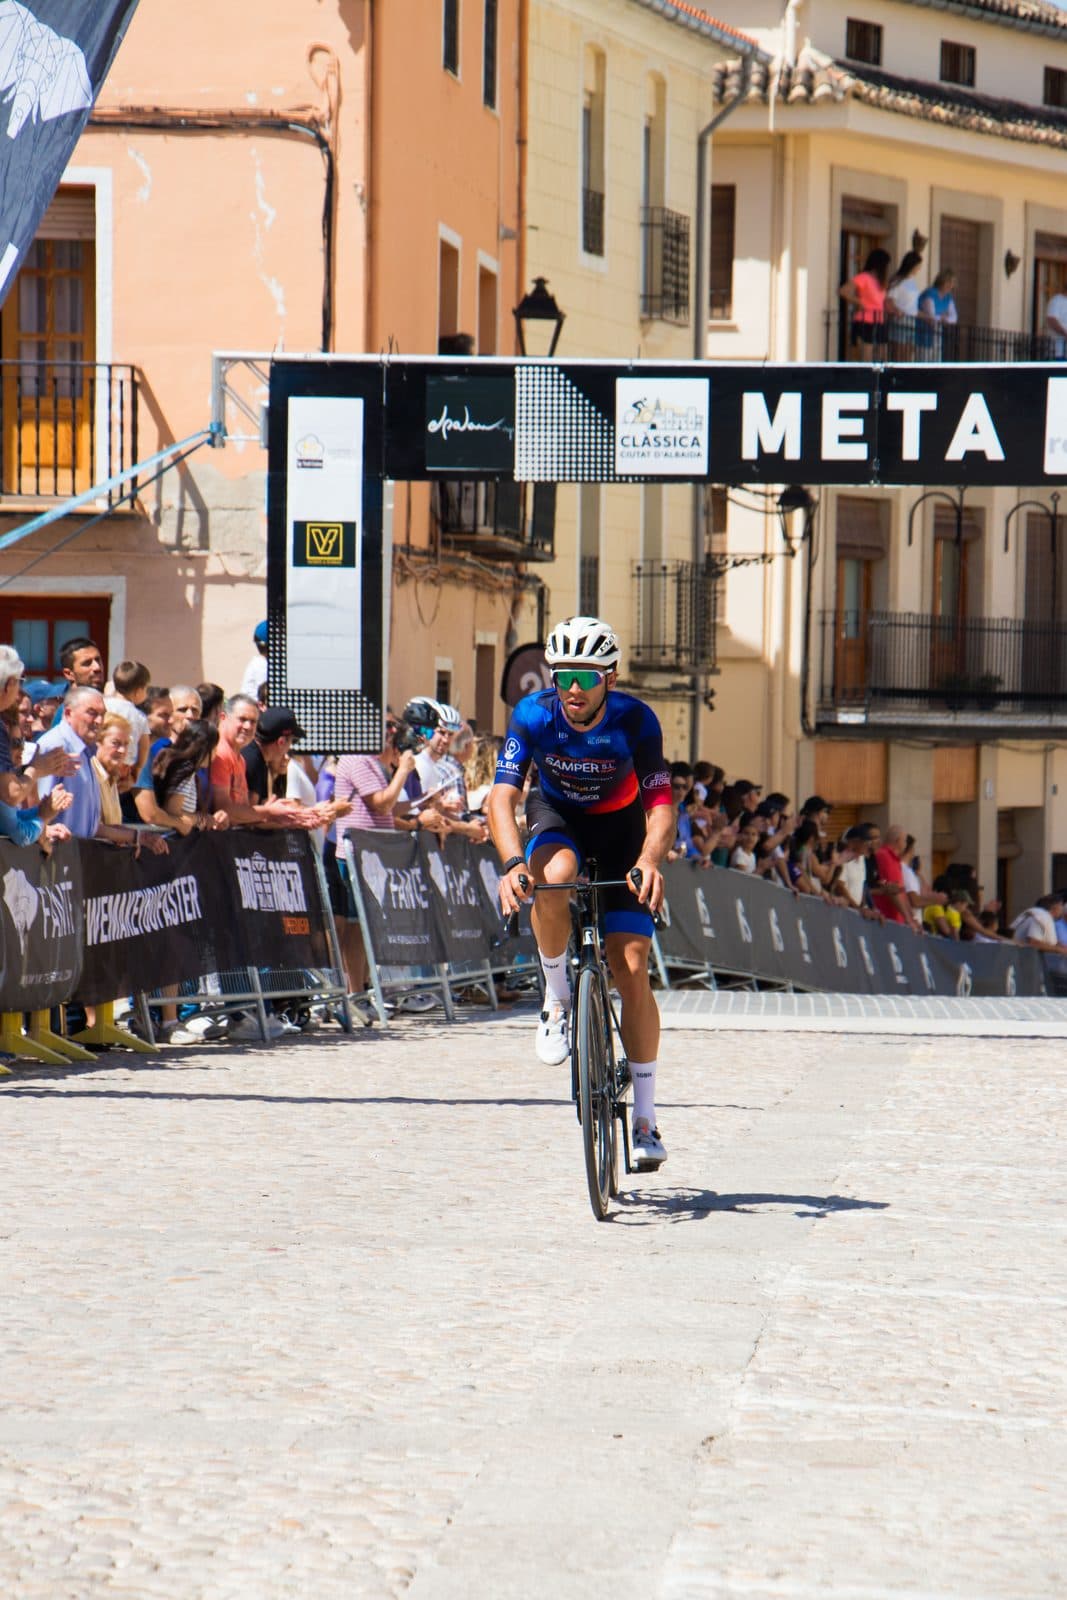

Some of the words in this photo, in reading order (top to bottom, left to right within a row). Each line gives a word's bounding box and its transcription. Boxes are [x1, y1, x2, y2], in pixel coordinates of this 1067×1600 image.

[741, 392, 1005, 461] META
[620, 451, 651, 459] CIUTAT
[545, 757, 600, 773] SAMPER
[83, 874, 202, 946] WEMAKEYOUFASTER
